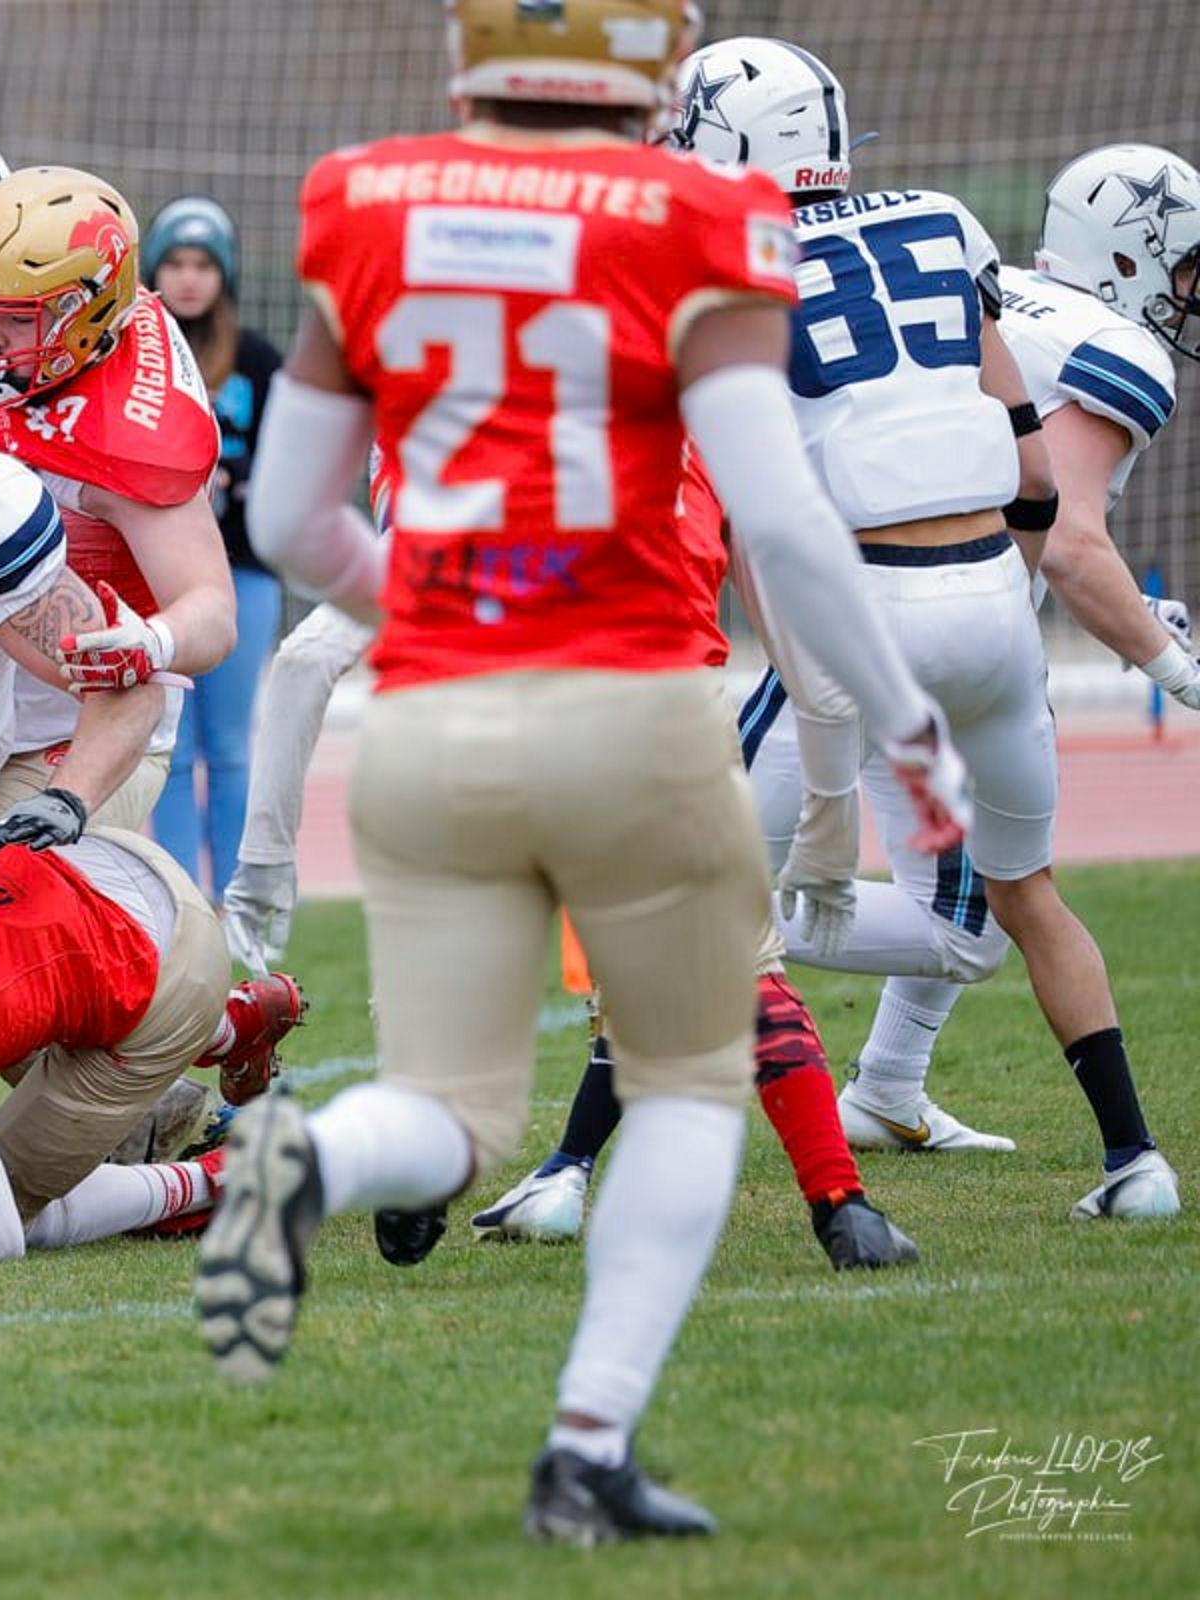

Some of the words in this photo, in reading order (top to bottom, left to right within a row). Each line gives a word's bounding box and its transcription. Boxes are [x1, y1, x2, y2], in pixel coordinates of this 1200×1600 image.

[347, 160, 669, 225] ARGONAUTES
[787, 213, 981, 398] 85
[374, 292, 616, 530] 21
